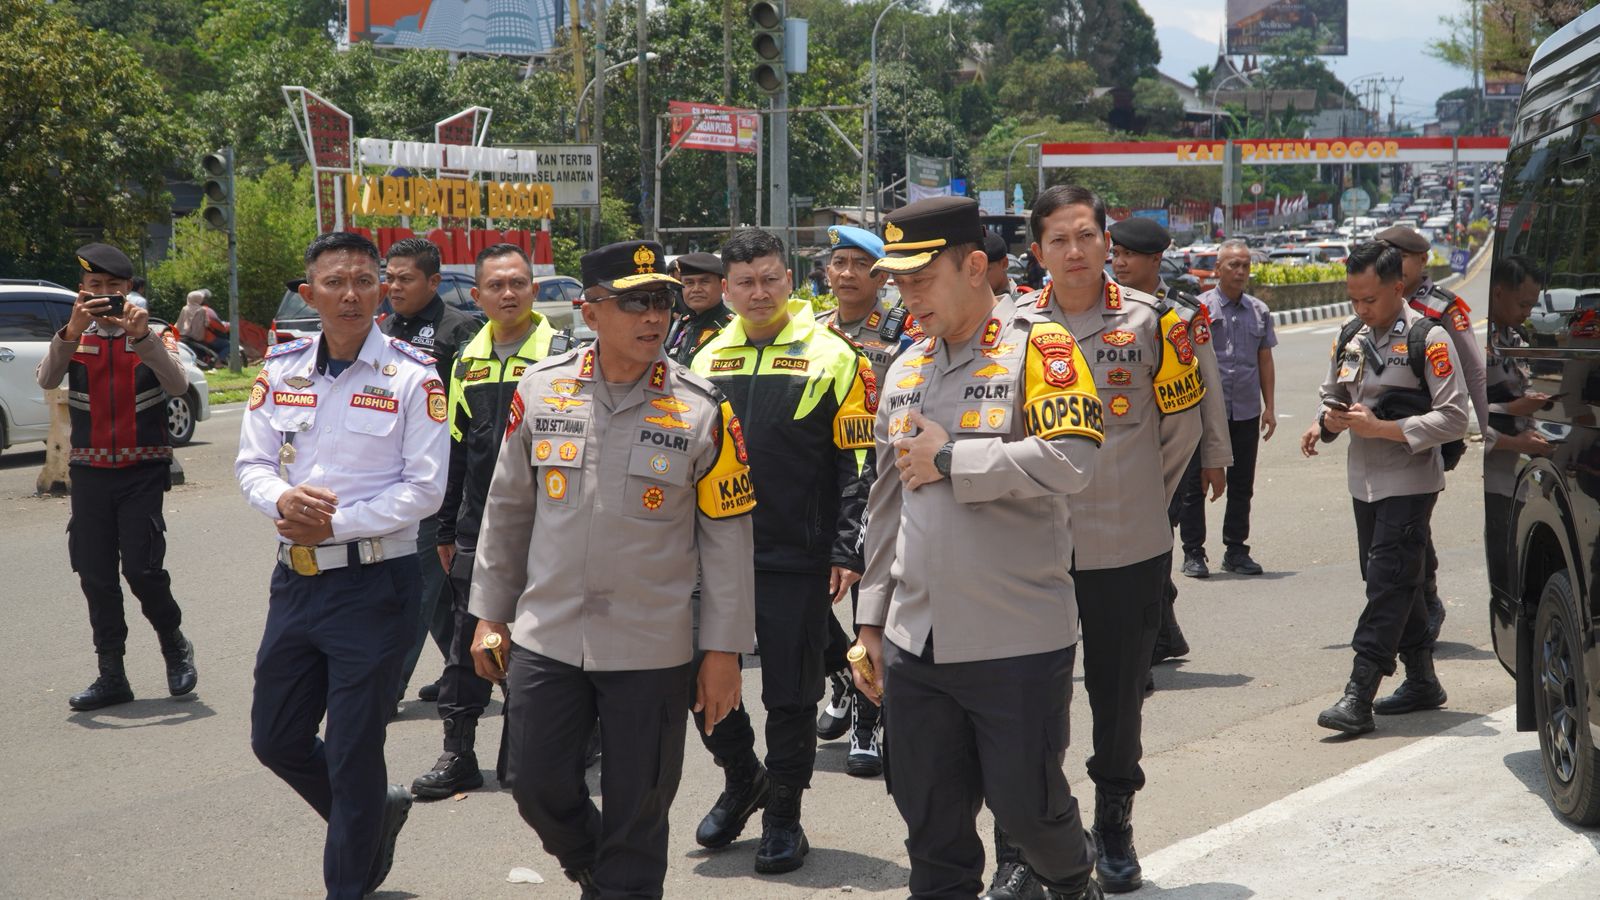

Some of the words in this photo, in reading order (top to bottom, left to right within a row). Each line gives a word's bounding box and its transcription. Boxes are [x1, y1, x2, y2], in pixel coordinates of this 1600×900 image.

[1177, 142, 1311, 161] KABPATEN
[1315, 140, 1399, 159] BOGOR
[536, 154, 557, 166] KAN
[560, 154, 592, 166] TERTIB
[346, 176, 482, 217] KABUPATEN
[487, 181, 555, 219] BOGOR
[864, 351, 887, 364] OLRI
[1096, 349, 1142, 363] POLRI
[1387, 357, 1409, 367] POL
[713, 359, 741, 369] RIZKA
[775, 359, 807, 370] POLISI
[964, 384, 1009, 400] POLRI
[1158, 372, 1196, 401] PAMAT
[275, 393, 315, 405] DADANG
[353, 396, 395, 410] DISHUB
[890, 391, 921, 411] WIKHA
[1042, 396, 1081, 431] OPS
[535, 418, 550, 432] RUDI
[640, 430, 689, 452] POLRI
[721, 500, 735, 511] OPS
